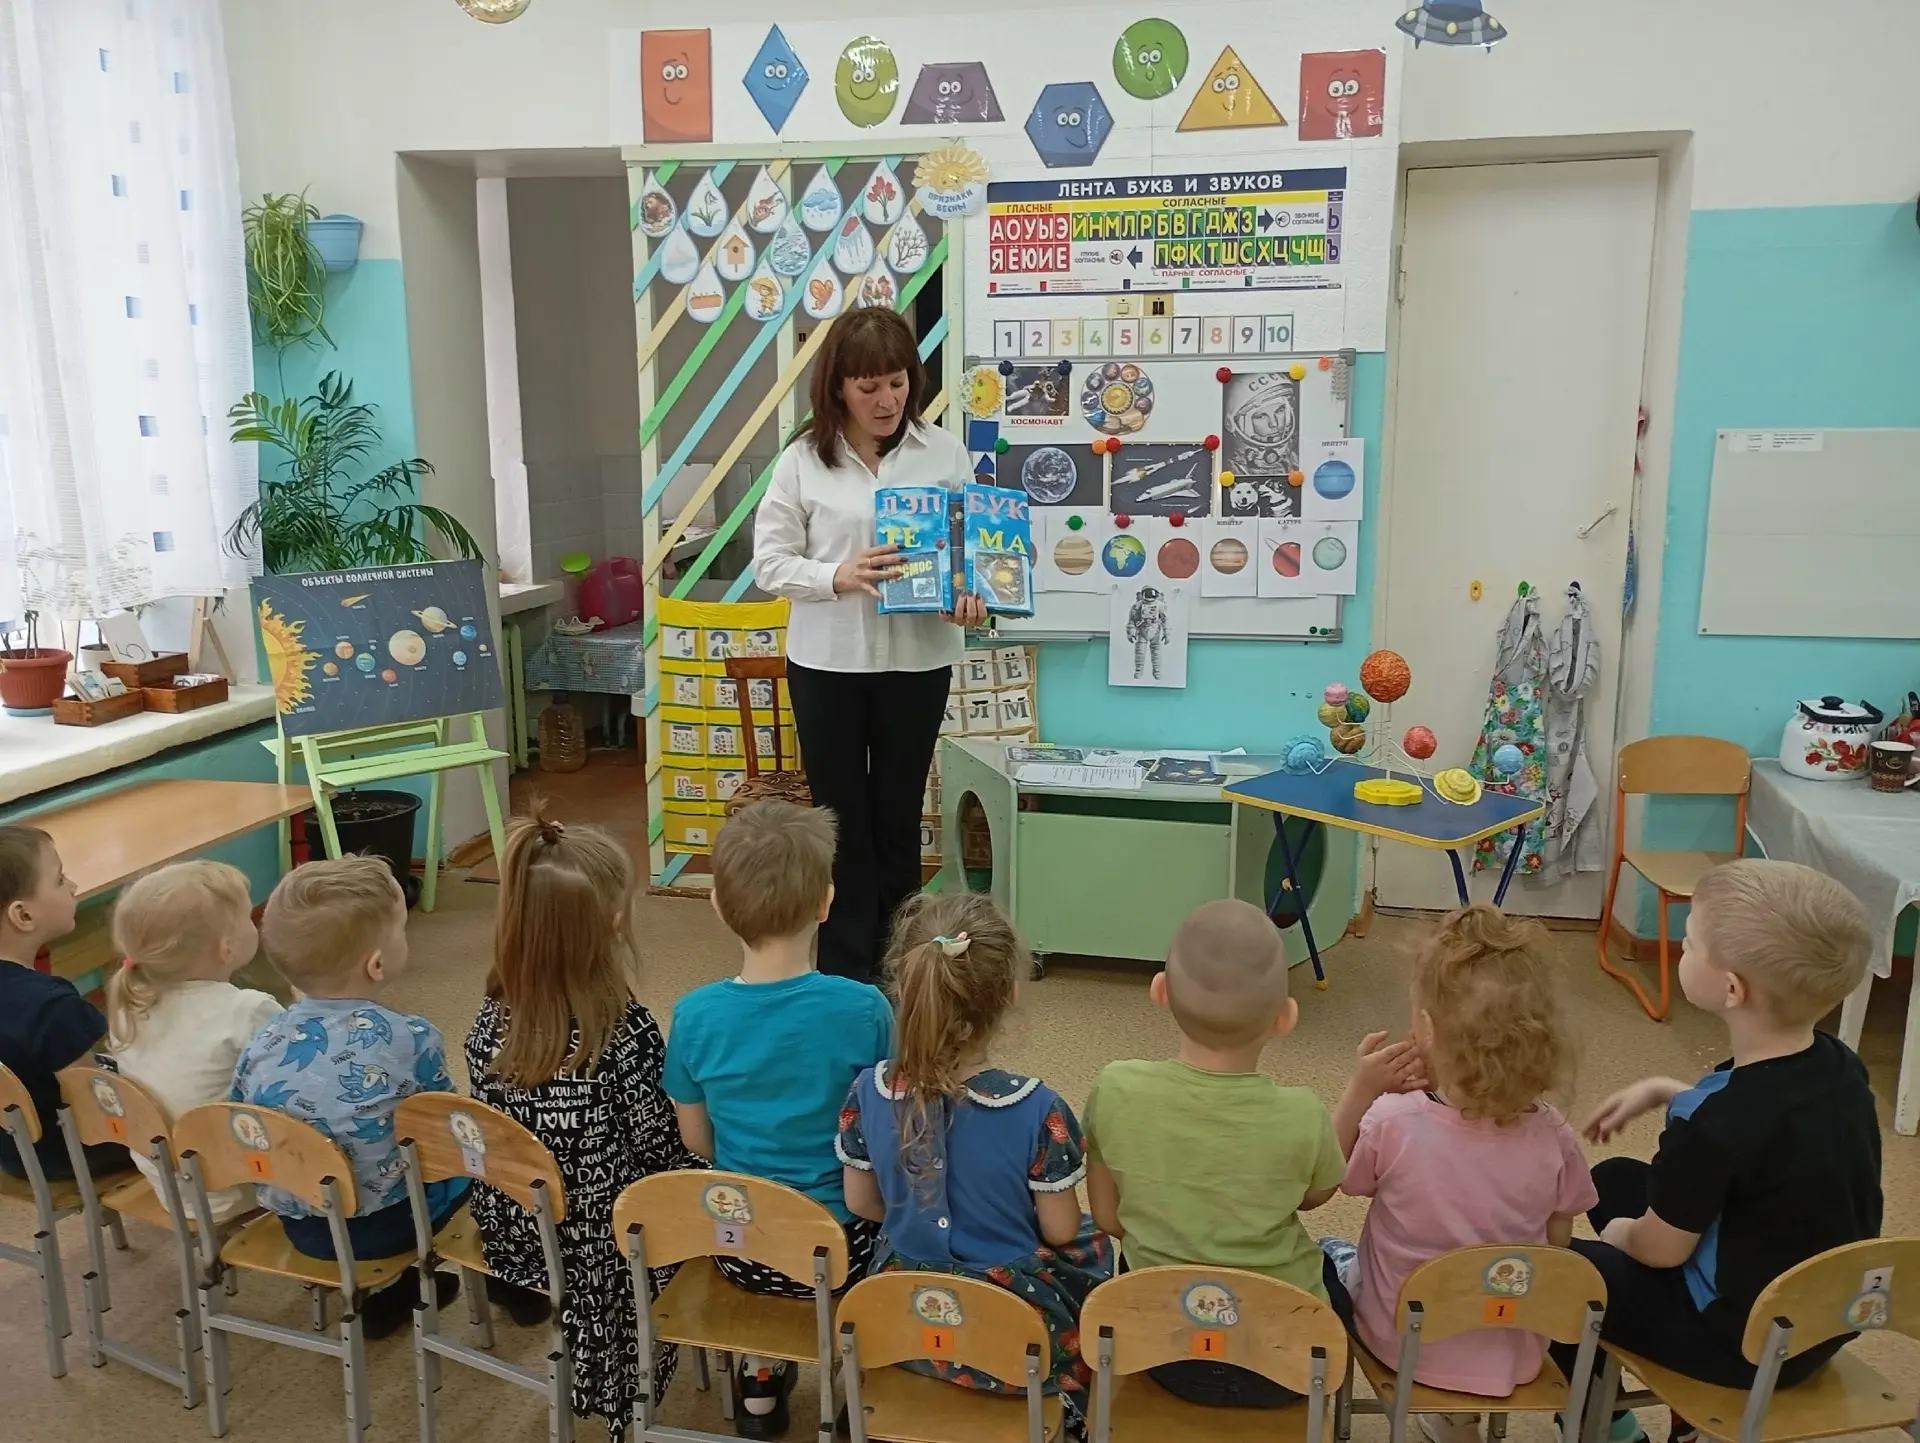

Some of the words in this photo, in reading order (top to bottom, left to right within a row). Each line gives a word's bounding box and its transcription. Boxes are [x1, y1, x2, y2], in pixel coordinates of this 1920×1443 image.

[1058, 182, 1116, 197] ЛЕНТА
[1127, 179, 1174, 194] БУКВ
[1185, 178, 1198, 192] И
[1209, 174, 1283, 191] ЗВУКОВ
[928, 189, 973, 203] ПРИЗНАКИ
[1162, 197, 1227, 207] СОГЛАСНЫЕ
[937, 202, 966, 213] ВЕСНЫ
[1006, 203, 1053, 213] ГЛАСНЫЕ
[1199, 269, 1247, 277] СОГЛАСНЫЕ
[1005, 331, 1013, 347] 1
[1031, 331, 1043, 347] 2
[1061, 330, 1072, 346] 3
[1089, 329, 1102, 346] 4
[1120, 329, 1132, 346] 5
[1150, 328, 1162, 345] 6
[1180, 327, 1192, 344] 7
[1210, 327, 1222, 344] 8
[1241, 327, 1254, 343] 9
[1267, 326, 1290, 343] 10
[967, 491, 1028, 520] БУК
[977, 527, 1027, 554] МА
[301, 575, 344, 587] ОБЪЕКТЫ
[345, 570, 394, 583] СОЛНЕЧНОЙ
[396, 567, 434, 579] СИСТЕМЫ
[725, 1231, 735, 1243] 2
[1872, 1275, 1882, 1289] 2
[1497, 1304, 1505, 1317] 1
[934, 1335, 942, 1348] 1
[1203, 1338, 1212, 1352] 1
